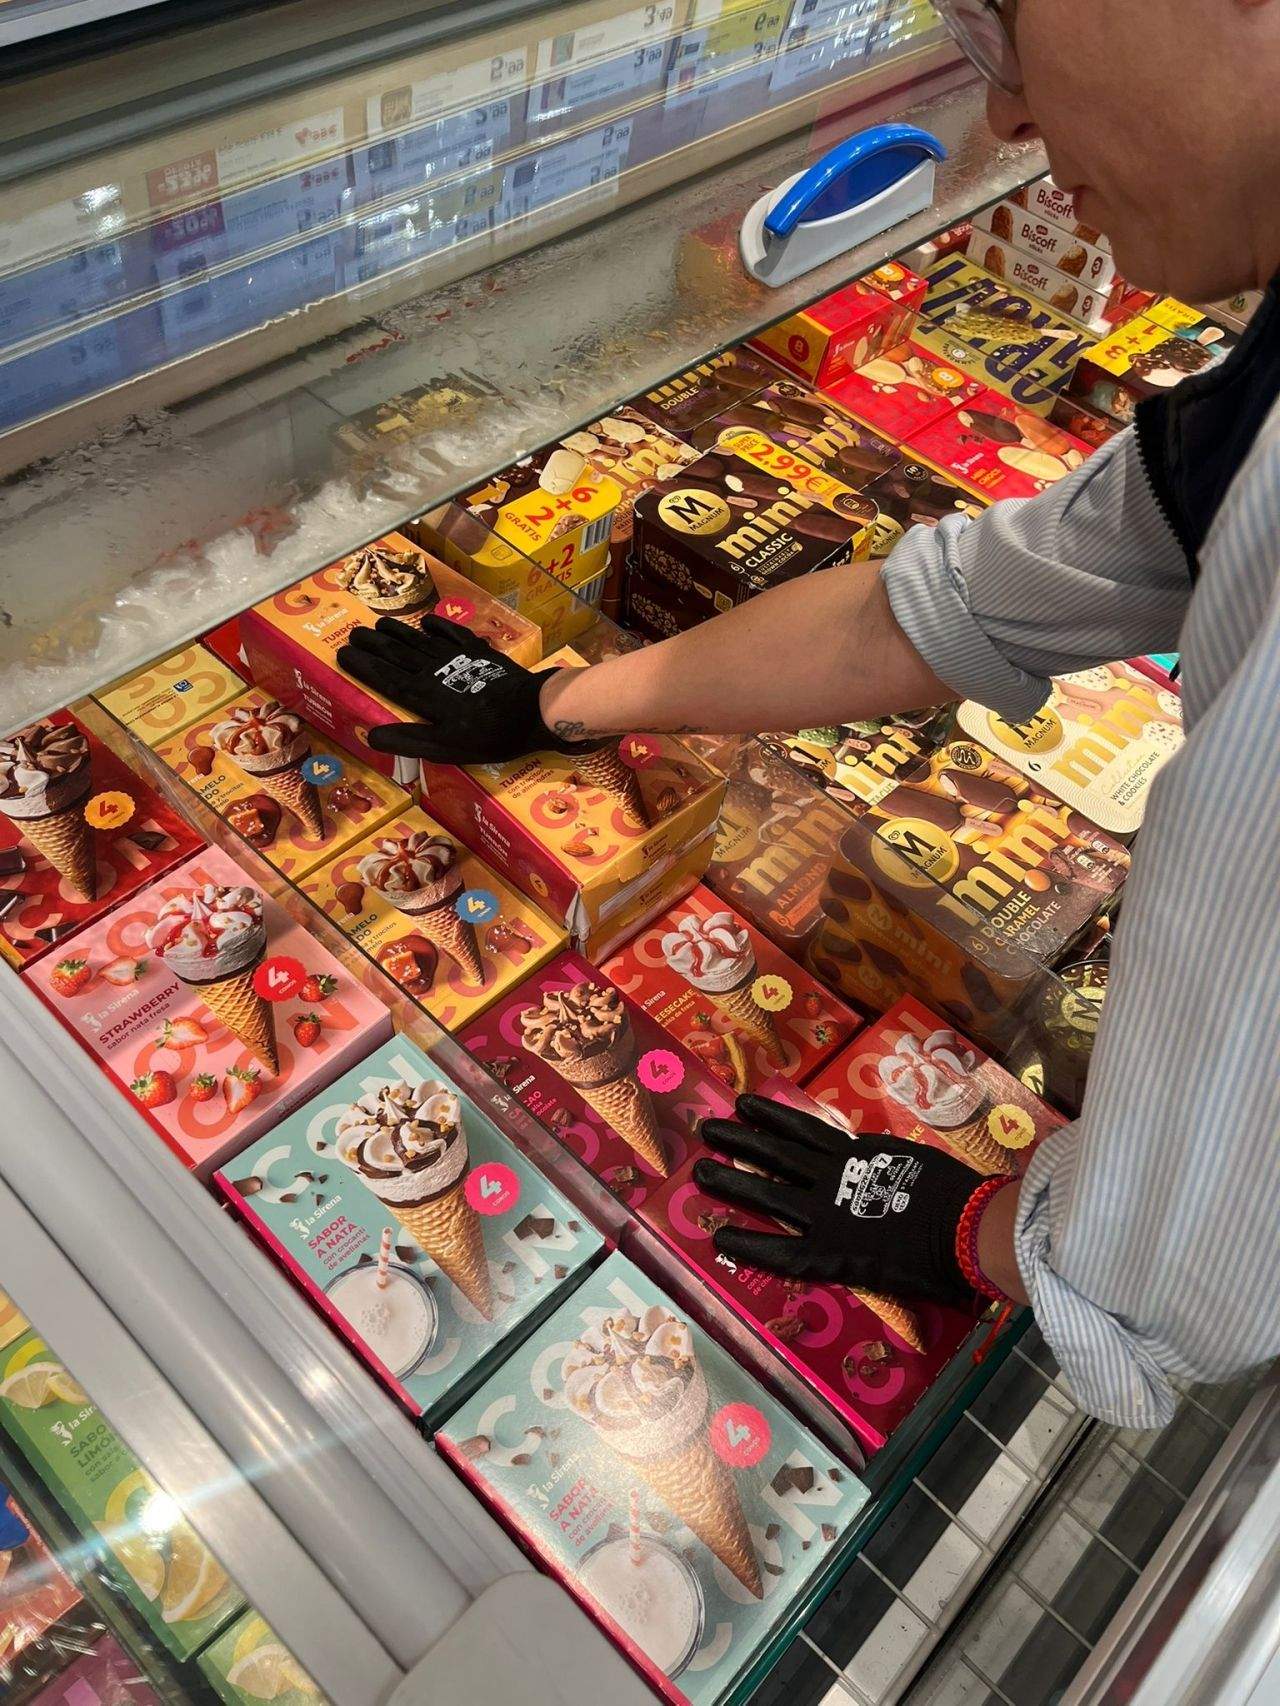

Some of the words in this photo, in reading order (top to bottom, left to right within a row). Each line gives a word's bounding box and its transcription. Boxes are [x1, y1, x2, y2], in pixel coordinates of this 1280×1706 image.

[1036, 188, 1073, 219] Biscoff
[1021, 223, 1057, 252] Biscoff
[1013, 263, 1049, 290] Biscoff
[660, 385, 700, 410] DOUBLE
[505, 511, 542, 542] GRATIS
[689, 507, 725, 532] MAGNUM
[714, 487, 815, 560] mini
[745, 532, 794, 568] CLASSIC
[445, 603, 464, 617] 4
[321, 619, 362, 645] TURRÓN
[1023, 719, 1057, 750] MAGNUM
[1050, 677, 1162, 790] mini
[629, 740, 649, 758] 4
[312, 761, 329, 776] 4
[499, 758, 543, 789] TURRÓN
[1110, 780, 1132, 802] WHITE
[1129, 750, 1161, 786] CHOCOLATE
[199, 774, 227, 796] MELO
[1123, 776, 1149, 803] COOKIES
[99, 800, 119, 818] 4
[714, 826, 754, 859] MAGNUM
[936, 799, 1072, 928] mini
[776, 862, 830, 910] ALMOND
[467, 896, 486, 913] 4
[980, 889, 1032, 939] DOUBLE
[348, 912, 379, 938] AMELO
[268, 966, 290, 988] 4
[110, 988, 141, 1012] Sirena
[762, 983, 779, 1000] 4
[99, 981, 181, 1044] STRAWBERRY
[654, 987, 696, 1024] EESECAKE
[106, 1033, 131, 1051] sabor
[130, 1017, 150, 1034] nata
[149, 1002, 171, 1020] fresa
[649, 1060, 670, 1080] 4
[512, 1074, 537, 1095] Sirena
[1000, 1114, 1020, 1135] 4
[479, 1174, 502, 1199] 4
[834, 1156, 869, 1207] TB
[304, 1216, 317, 1227] la
[313, 1194, 343, 1220] Sirena
[308, 1215, 347, 1250] SABOR
[316, 1248, 328, 1259] A
[325, 1222, 359, 1250] NATA
[323, 1252, 338, 1266] con
[327, 1260, 339, 1272] de
[338, 1233, 372, 1263] avellanas
[67, 1418, 81, 1431] la
[725, 1418, 751, 1448] 4
[70, 1424, 107, 1459] SABO
[541, 1480, 554, 1493] la
[548, 1477, 586, 1522] SABOR
[559, 1520, 571, 1532] A
[568, 1524, 583, 1540] con
[574, 1535, 586, 1547] de
